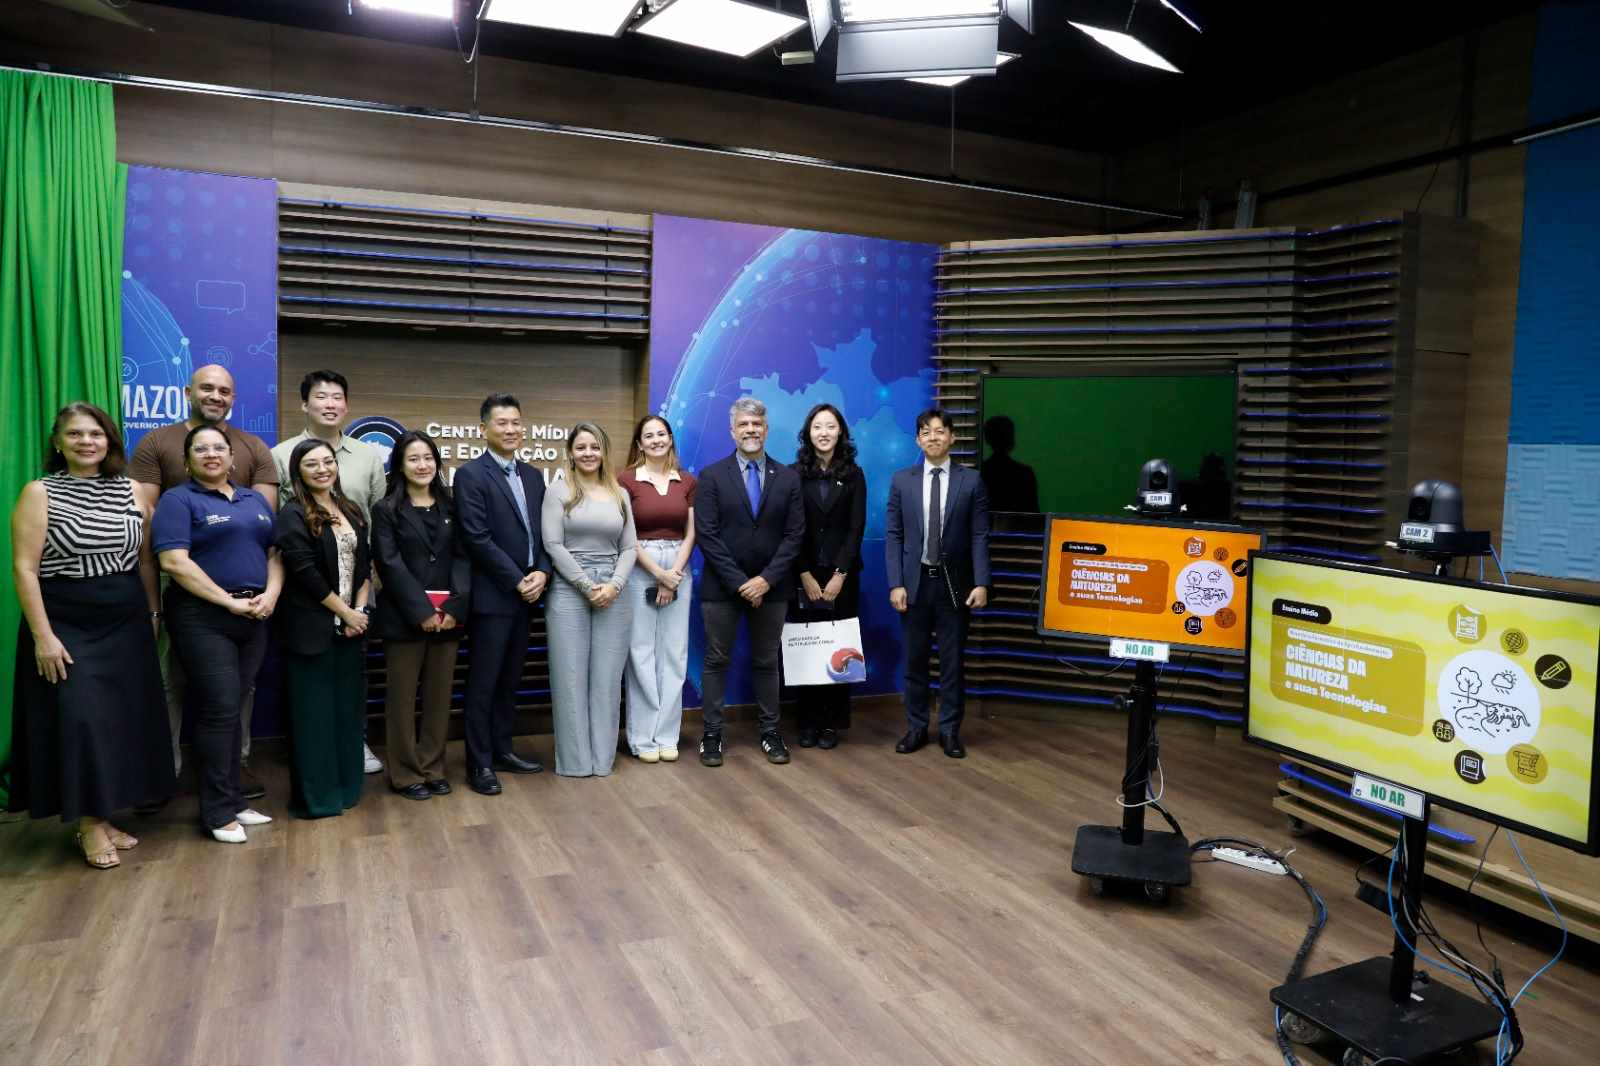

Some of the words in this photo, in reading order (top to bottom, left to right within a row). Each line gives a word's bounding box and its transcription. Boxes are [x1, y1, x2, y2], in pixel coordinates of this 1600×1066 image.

[426, 422, 482, 438] CENT
[532, 424, 569, 440] MÍDI
[1405, 527, 1422, 536] CAM
[1422, 529, 1429, 538] 2
[1071, 580, 1117, 593] NATUREZA
[1117, 573, 1130, 584] DA
[1125, 643, 1139, 654] NO
[1141, 645, 1154, 656] AR
[1286, 643, 1345, 671] CIÊNCIAS
[1347, 658, 1367, 677] DA
[1285, 661, 1349, 690] NATUREZA
[1285, 680, 1292, 689] e
[1294, 682, 1318, 697] suas
[1319, 687, 1387, 714] Tecnologias
[1370, 784, 1387, 801] NO
[1389, 790, 1405, 807] AR
